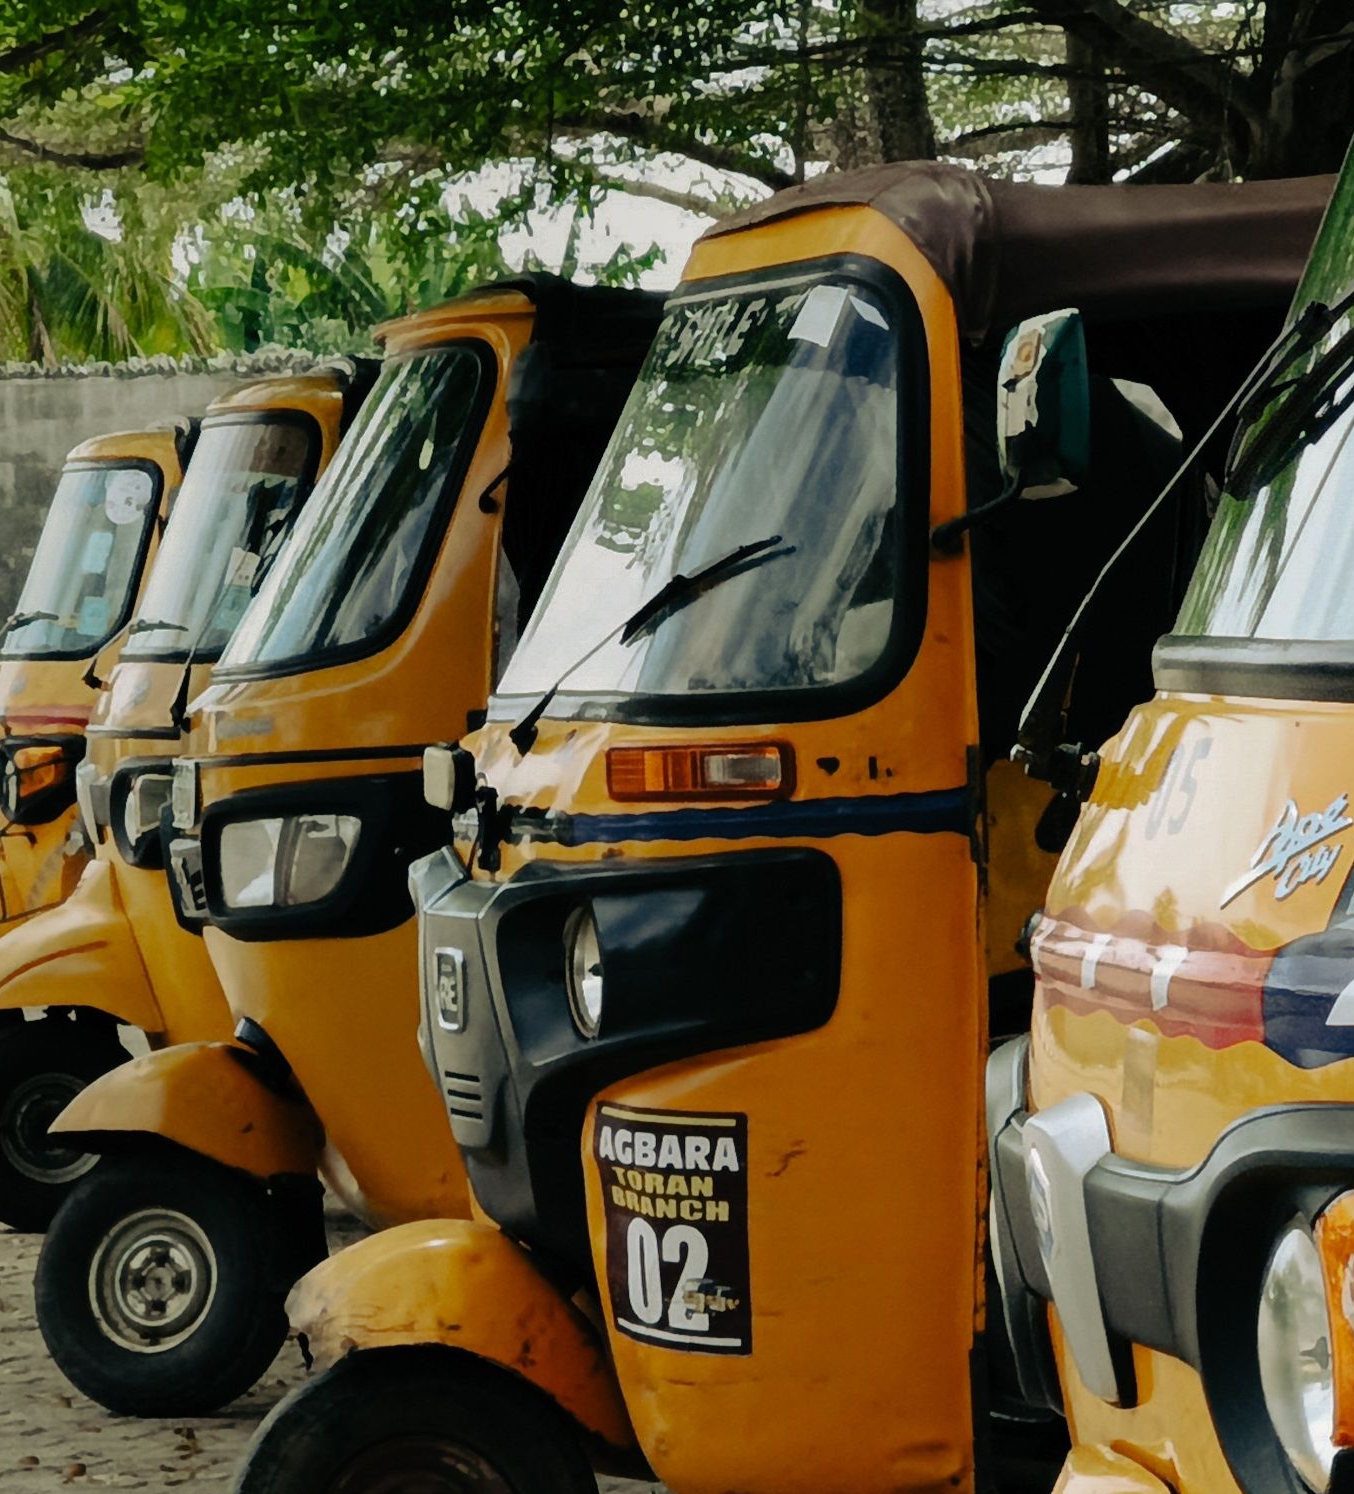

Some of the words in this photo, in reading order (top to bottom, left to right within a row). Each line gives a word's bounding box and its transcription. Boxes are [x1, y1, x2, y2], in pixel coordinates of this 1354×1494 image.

[599, 1126, 740, 1172] AGBARA
[611, 1166, 714, 1197] TORAN
[611, 1185, 729, 1222] BRANCH
[627, 1217, 710, 1331] 02
